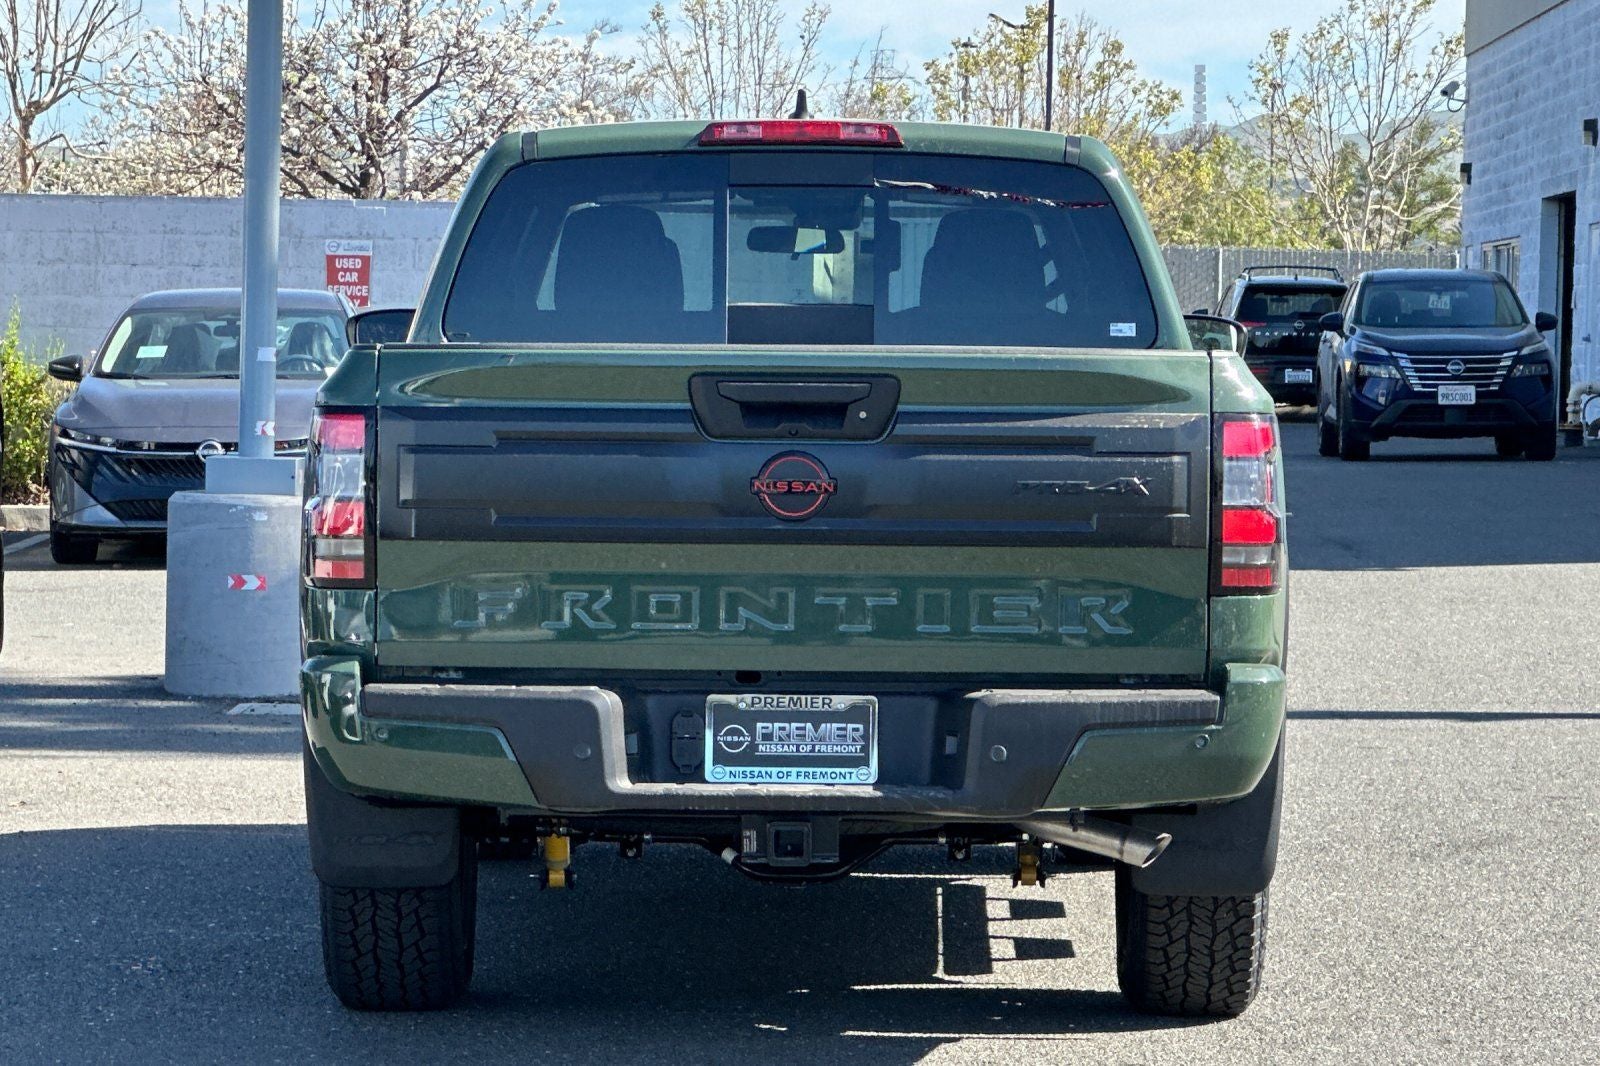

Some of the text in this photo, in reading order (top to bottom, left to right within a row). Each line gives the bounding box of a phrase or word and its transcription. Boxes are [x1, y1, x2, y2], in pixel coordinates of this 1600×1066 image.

[335, 257, 362, 269] USED
[337, 271, 359, 283] CAR
[753, 480, 834, 492] NISSAN
[451, 583, 1133, 634] FRONTIER
[750, 696, 833, 709] PREMIER
[755, 722, 865, 743] PREMIER
[758, 744, 862, 753] NISSAN OF FREMONT
[728, 770, 855, 780] NISSAN OF FREMONT
